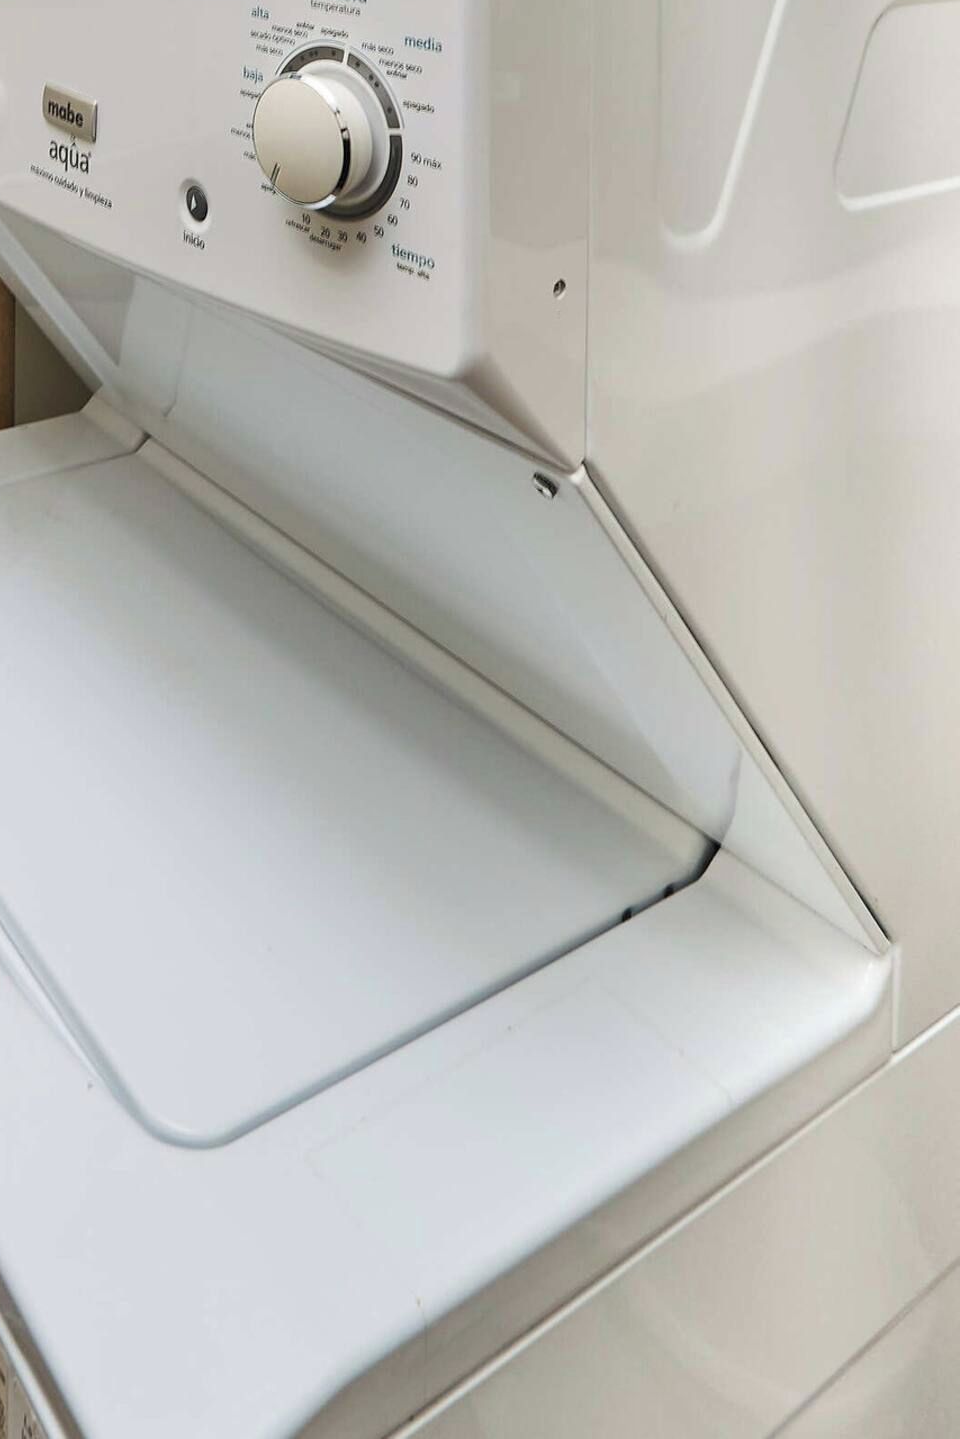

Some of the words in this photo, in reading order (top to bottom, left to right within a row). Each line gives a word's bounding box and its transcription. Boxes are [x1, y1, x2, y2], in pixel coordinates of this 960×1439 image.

[251, 6, 270, 20] alta
[310, 0, 361, 17] temperatura
[404, 36, 443, 53] media
[242, 64, 264, 84] baja
[48, 99, 84, 128] mabe
[410, 152, 422, 165] 90
[407, 174, 418, 187] 80
[54, 177, 78, 194] cuidado
[78, 187, 85, 198] y
[85, 187, 113, 209] limpieza
[399, 197, 410, 211] 70
[301, 213, 311, 225] 10
[387, 214, 398, 227] 60
[320, 226, 331, 240] 20
[337, 230, 348, 243] 30
[355, 231, 367, 244] 40
[373, 226, 384, 239] 50
[183, 230, 205, 250] inicio
[391, 243, 435, 270] tiempo
